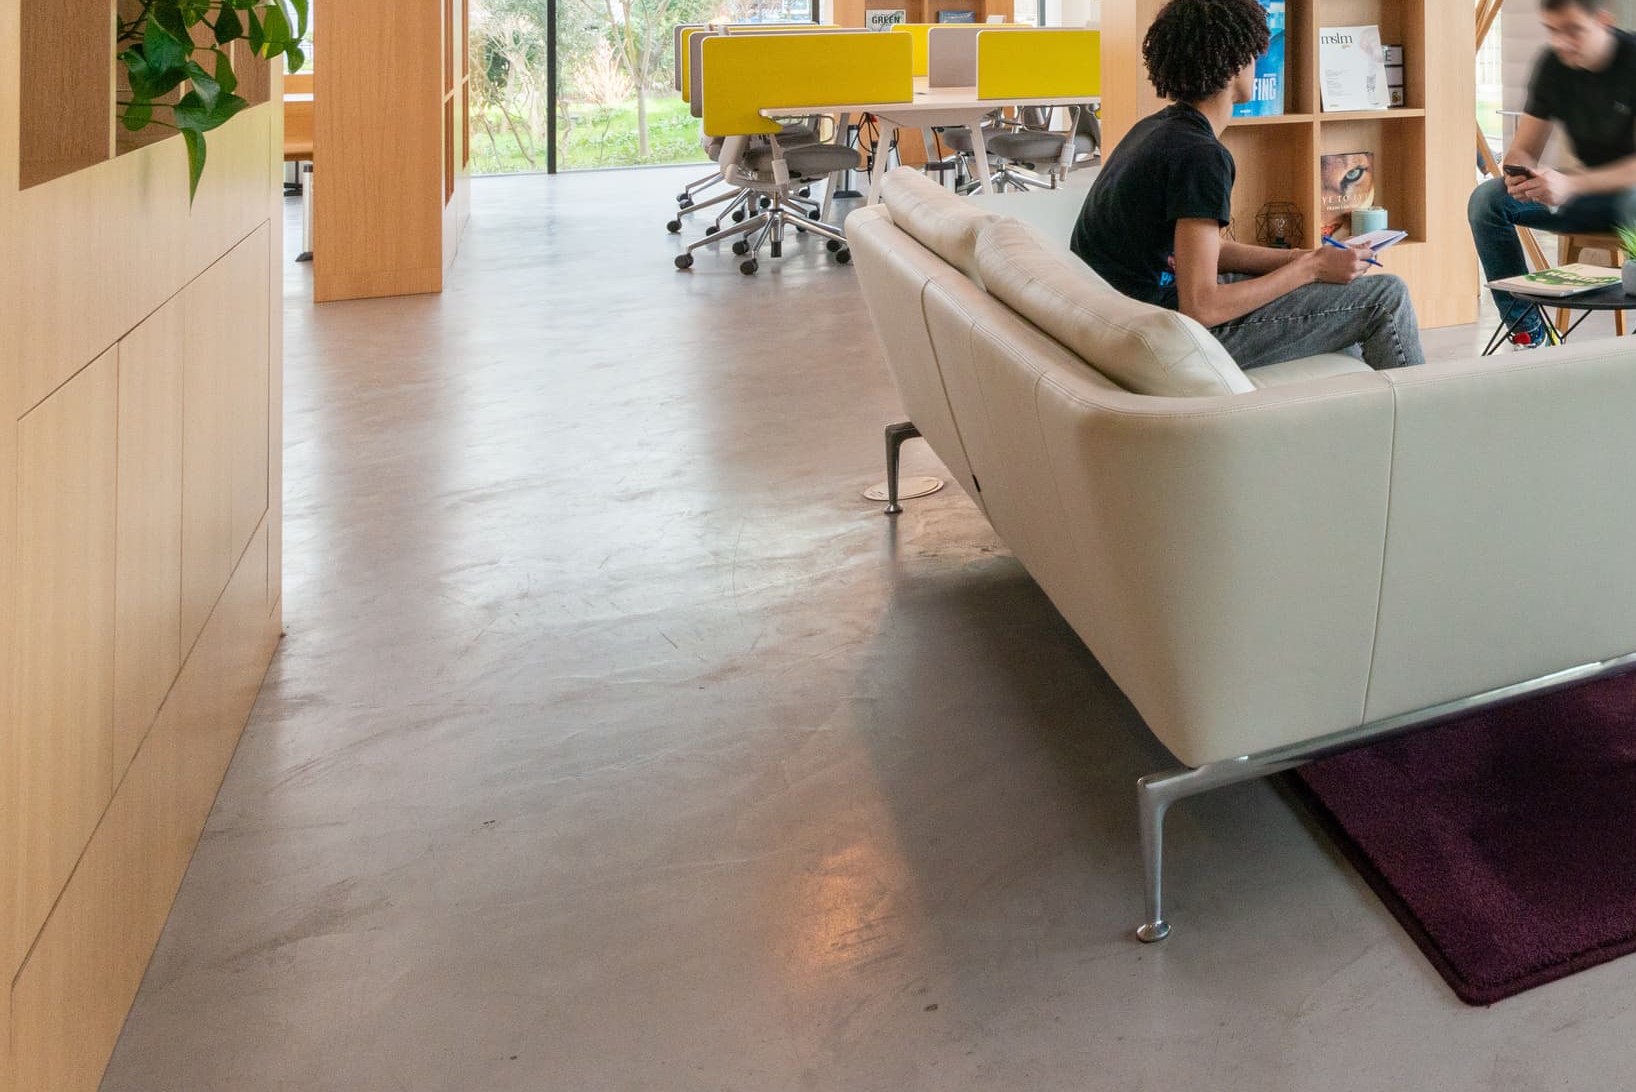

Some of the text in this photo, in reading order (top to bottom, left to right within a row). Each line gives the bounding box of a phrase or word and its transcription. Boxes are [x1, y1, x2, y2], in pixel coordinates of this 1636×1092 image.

[871, 15, 900, 24] GREEN
[1252, 77, 1277, 101] FING
[1321, 195, 1333, 205] YE
